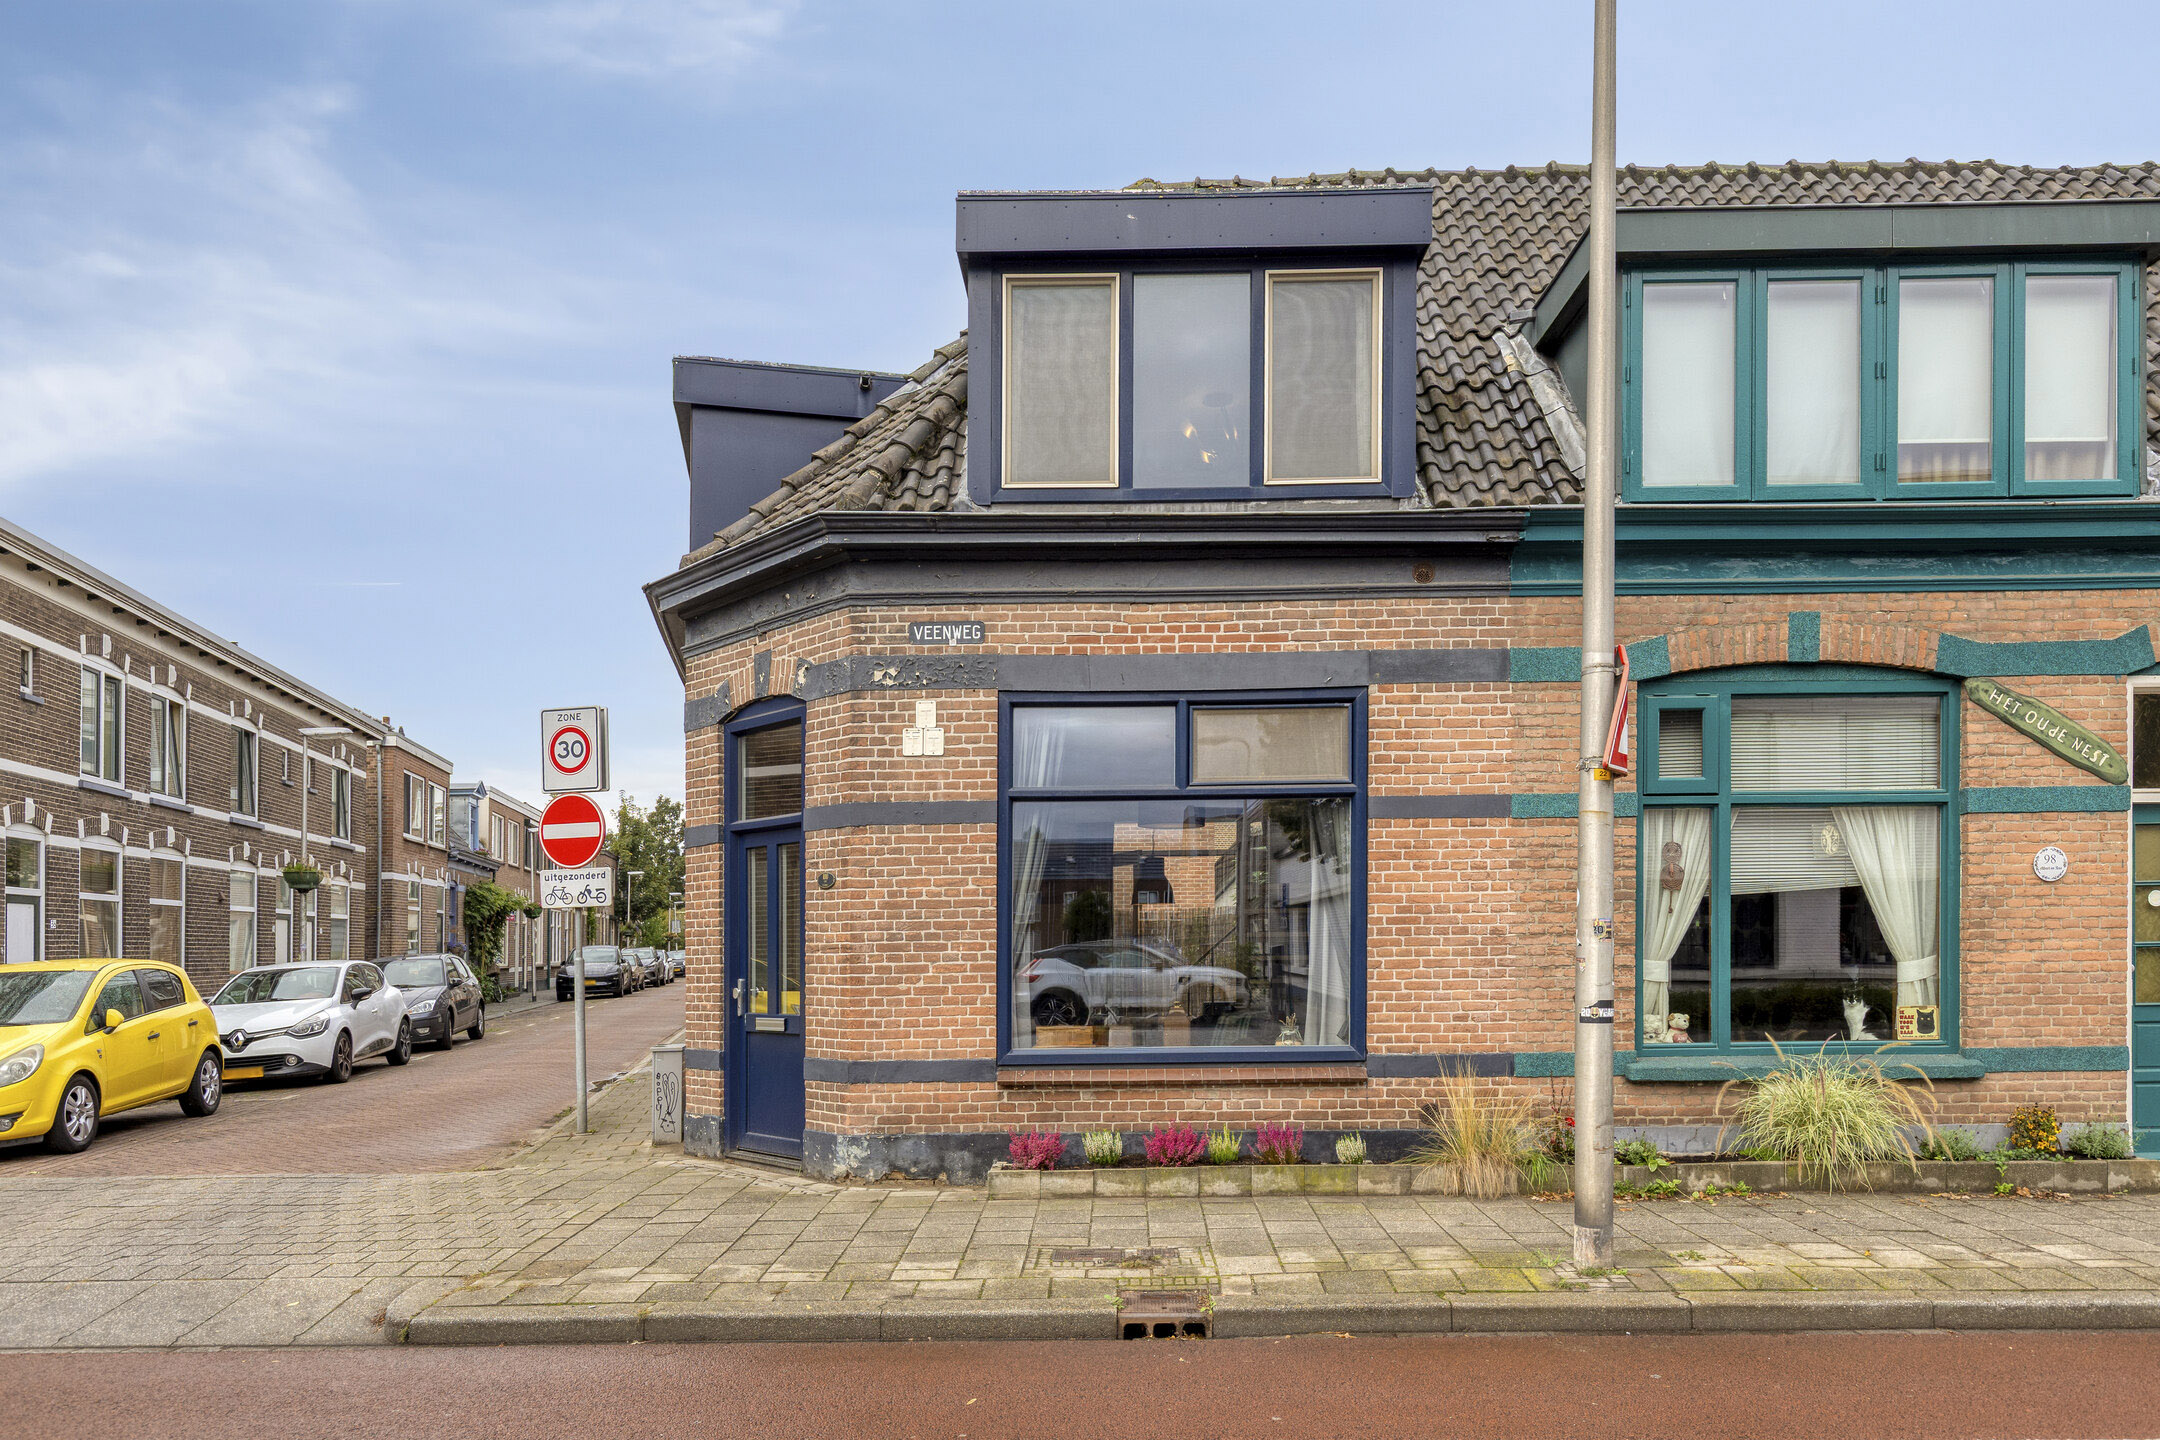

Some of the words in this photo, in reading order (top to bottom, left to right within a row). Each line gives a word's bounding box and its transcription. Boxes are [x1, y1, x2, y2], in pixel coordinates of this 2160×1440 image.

[914, 625, 981, 640] VEENWEG
[557, 712, 582, 722] ZONE
[1989, 688, 2023, 714] HET
[2071, 737, 2110, 767] NEST
[557, 739, 584, 759] 30
[2044, 853, 2057, 864] 98
[544, 871, 606, 883] uitgezonderd
[1581, 1008, 1590, 1016] 20
